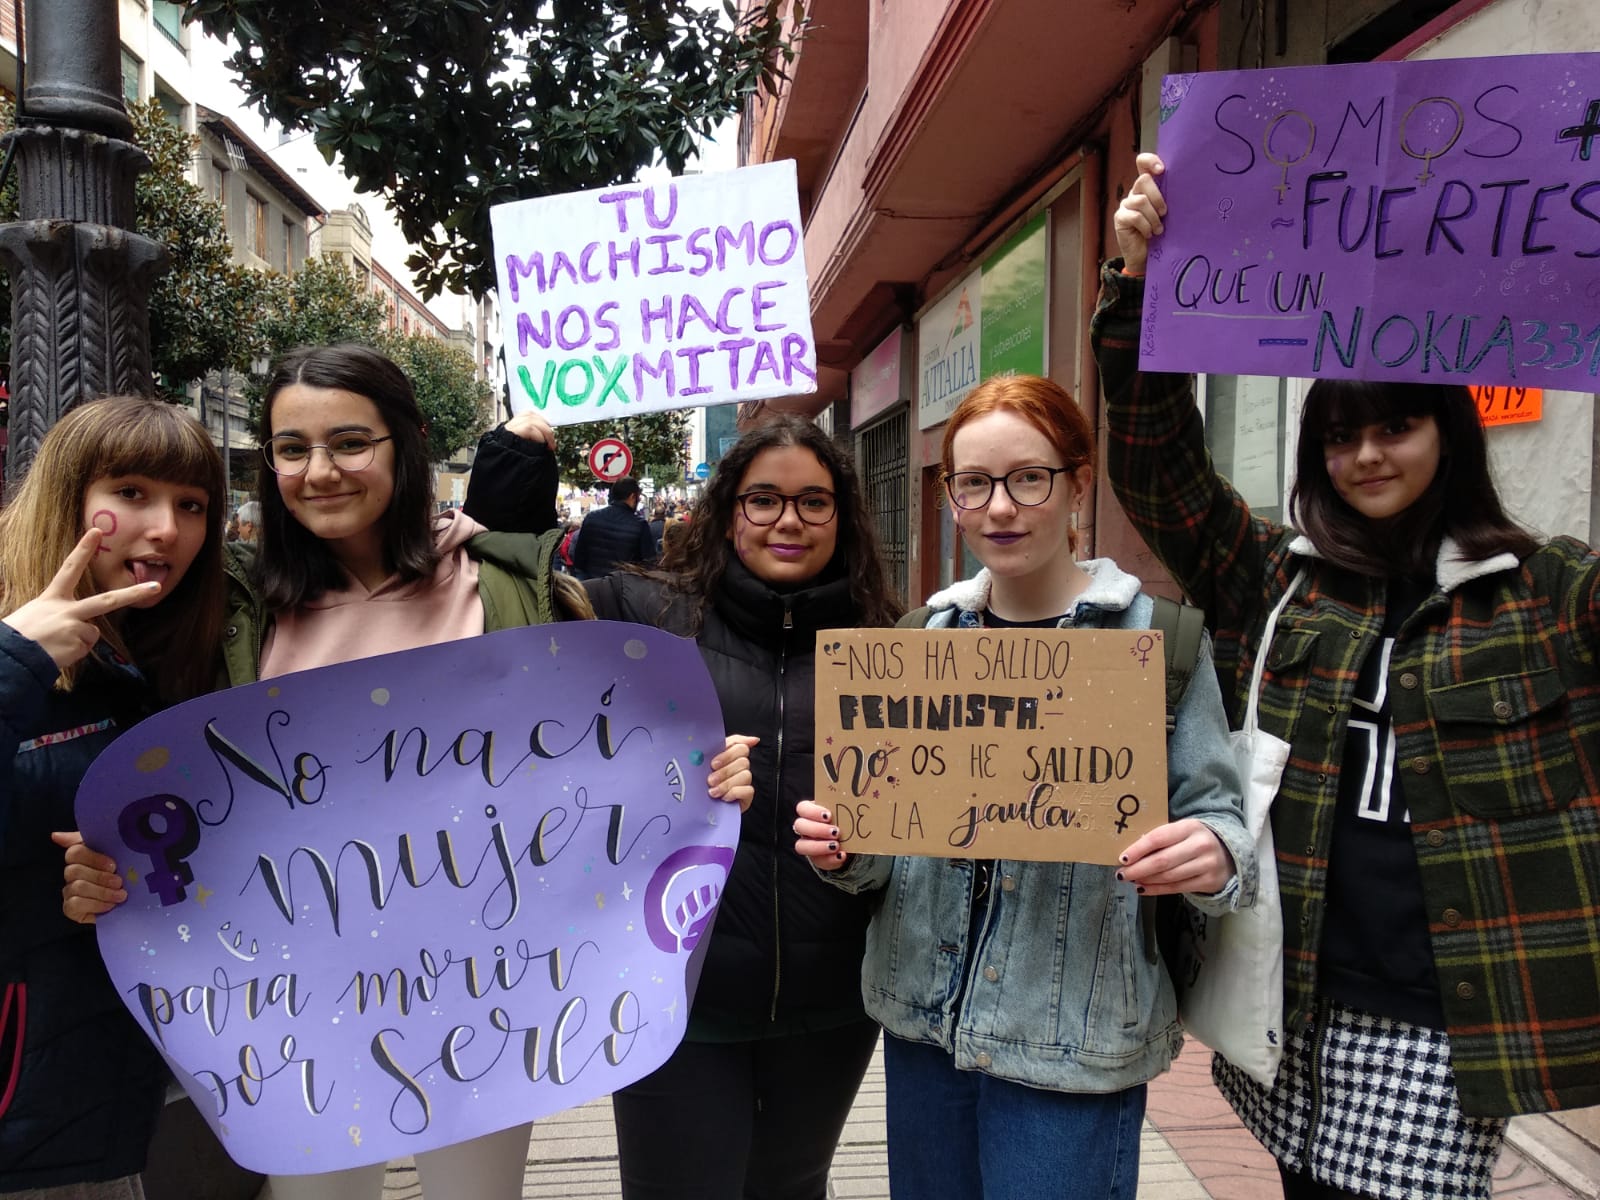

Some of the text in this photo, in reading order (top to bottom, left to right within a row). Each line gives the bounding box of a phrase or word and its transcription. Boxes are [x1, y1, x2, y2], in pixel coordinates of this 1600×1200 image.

[1214, 84, 1523, 204] SOMOS
[599, 183, 678, 233] TU
[506, 219, 799, 303] MACHISMO
[1174, 254, 1326, 313] QUE UN
[516, 280, 788, 357] NOS HACE
[924, 639, 959, 681] HA
[974, 636, 1071, 681] SALIDO
[197, 710, 332, 827] No
[911, 744, 947, 777] OS
[970, 743, 1000, 779] HE
[1023, 745, 1134, 784] SALIDO
[835, 802, 873, 844] DE
[890, 801, 925, 841] LA
[128, 938, 601, 1043] para morir
